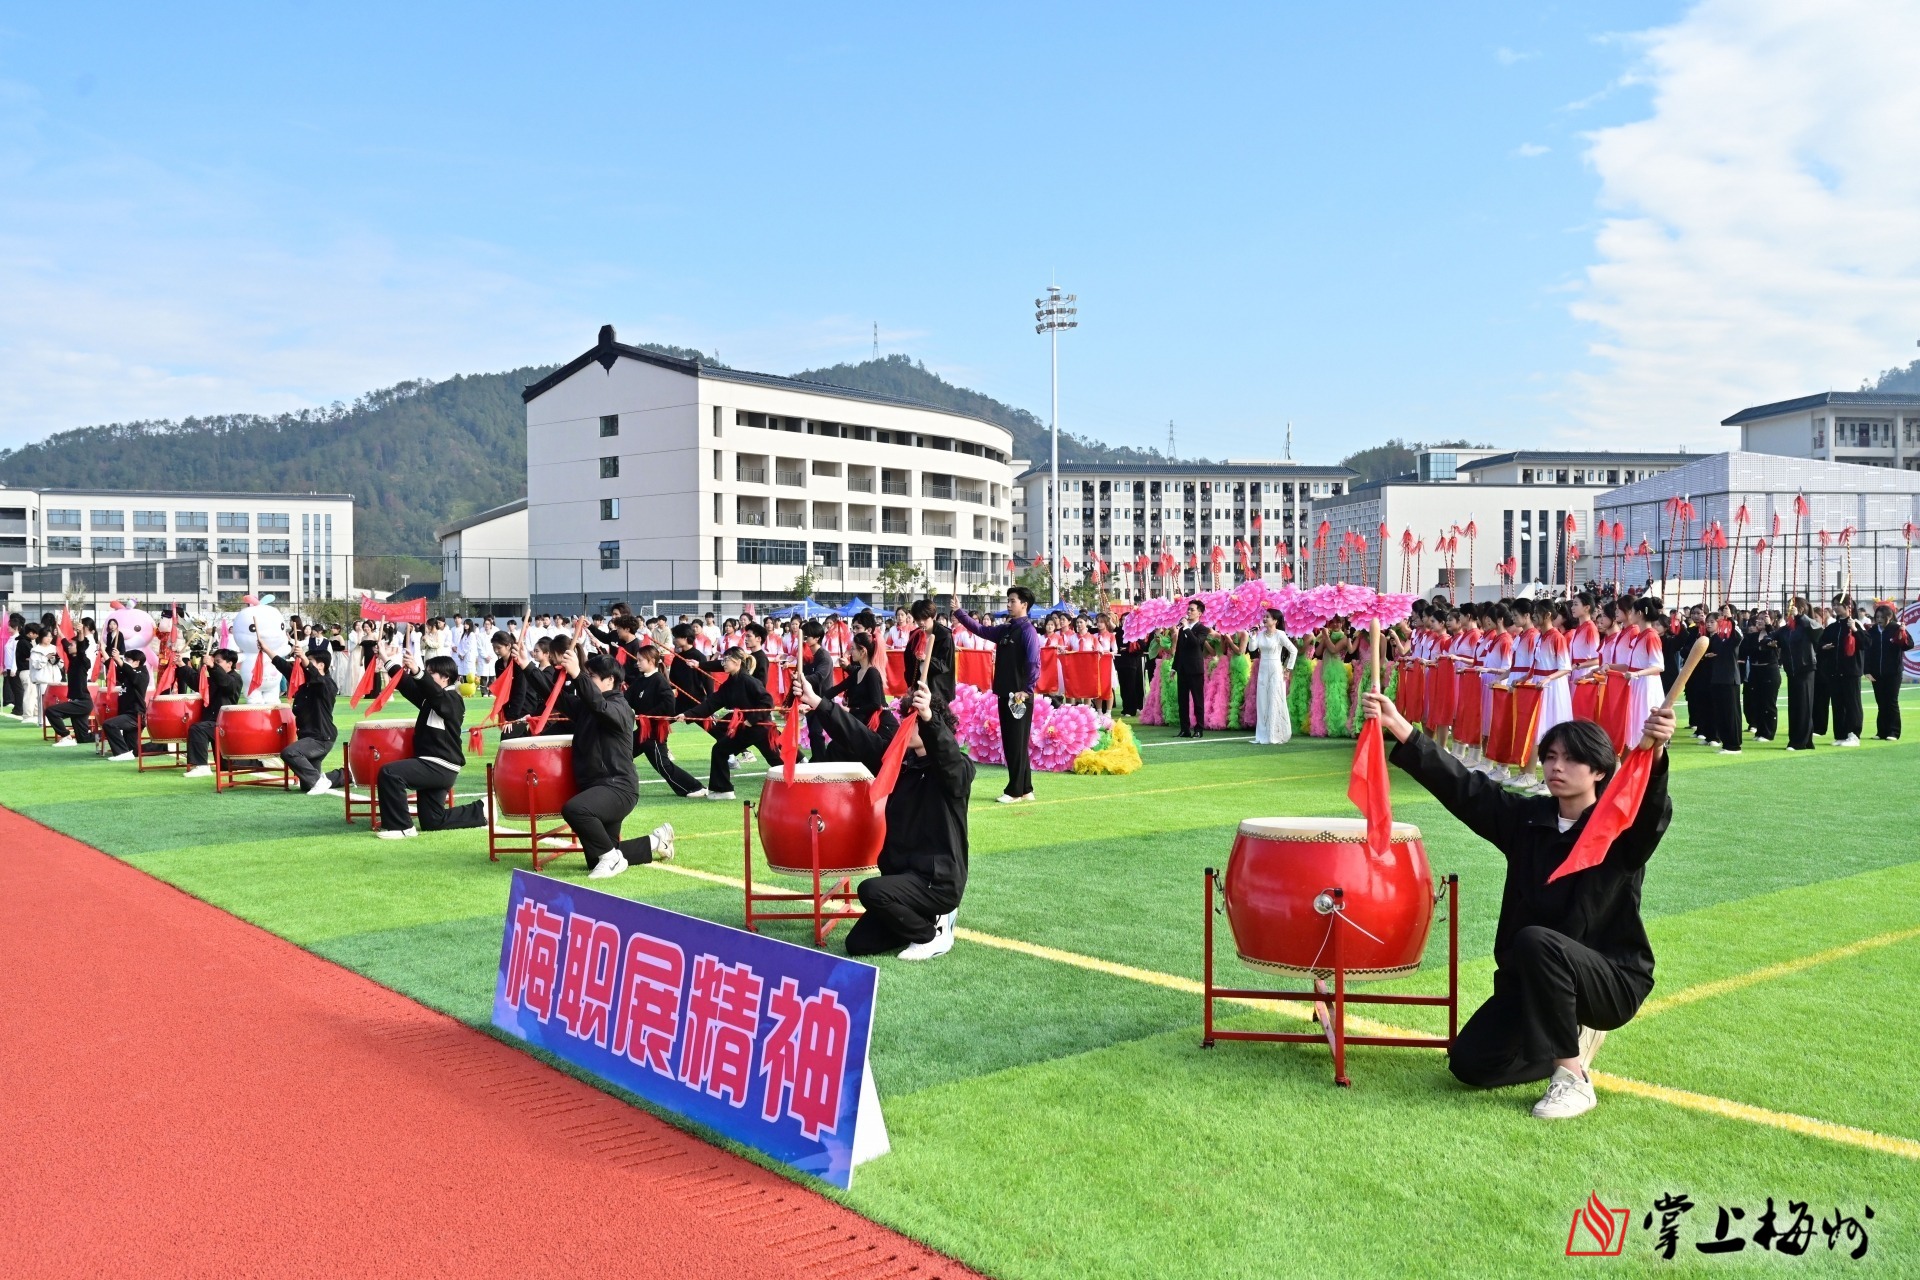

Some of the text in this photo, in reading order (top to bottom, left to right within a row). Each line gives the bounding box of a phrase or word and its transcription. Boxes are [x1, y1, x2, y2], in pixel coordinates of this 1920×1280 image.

[505, 897, 851, 1142] 梅职展精神
